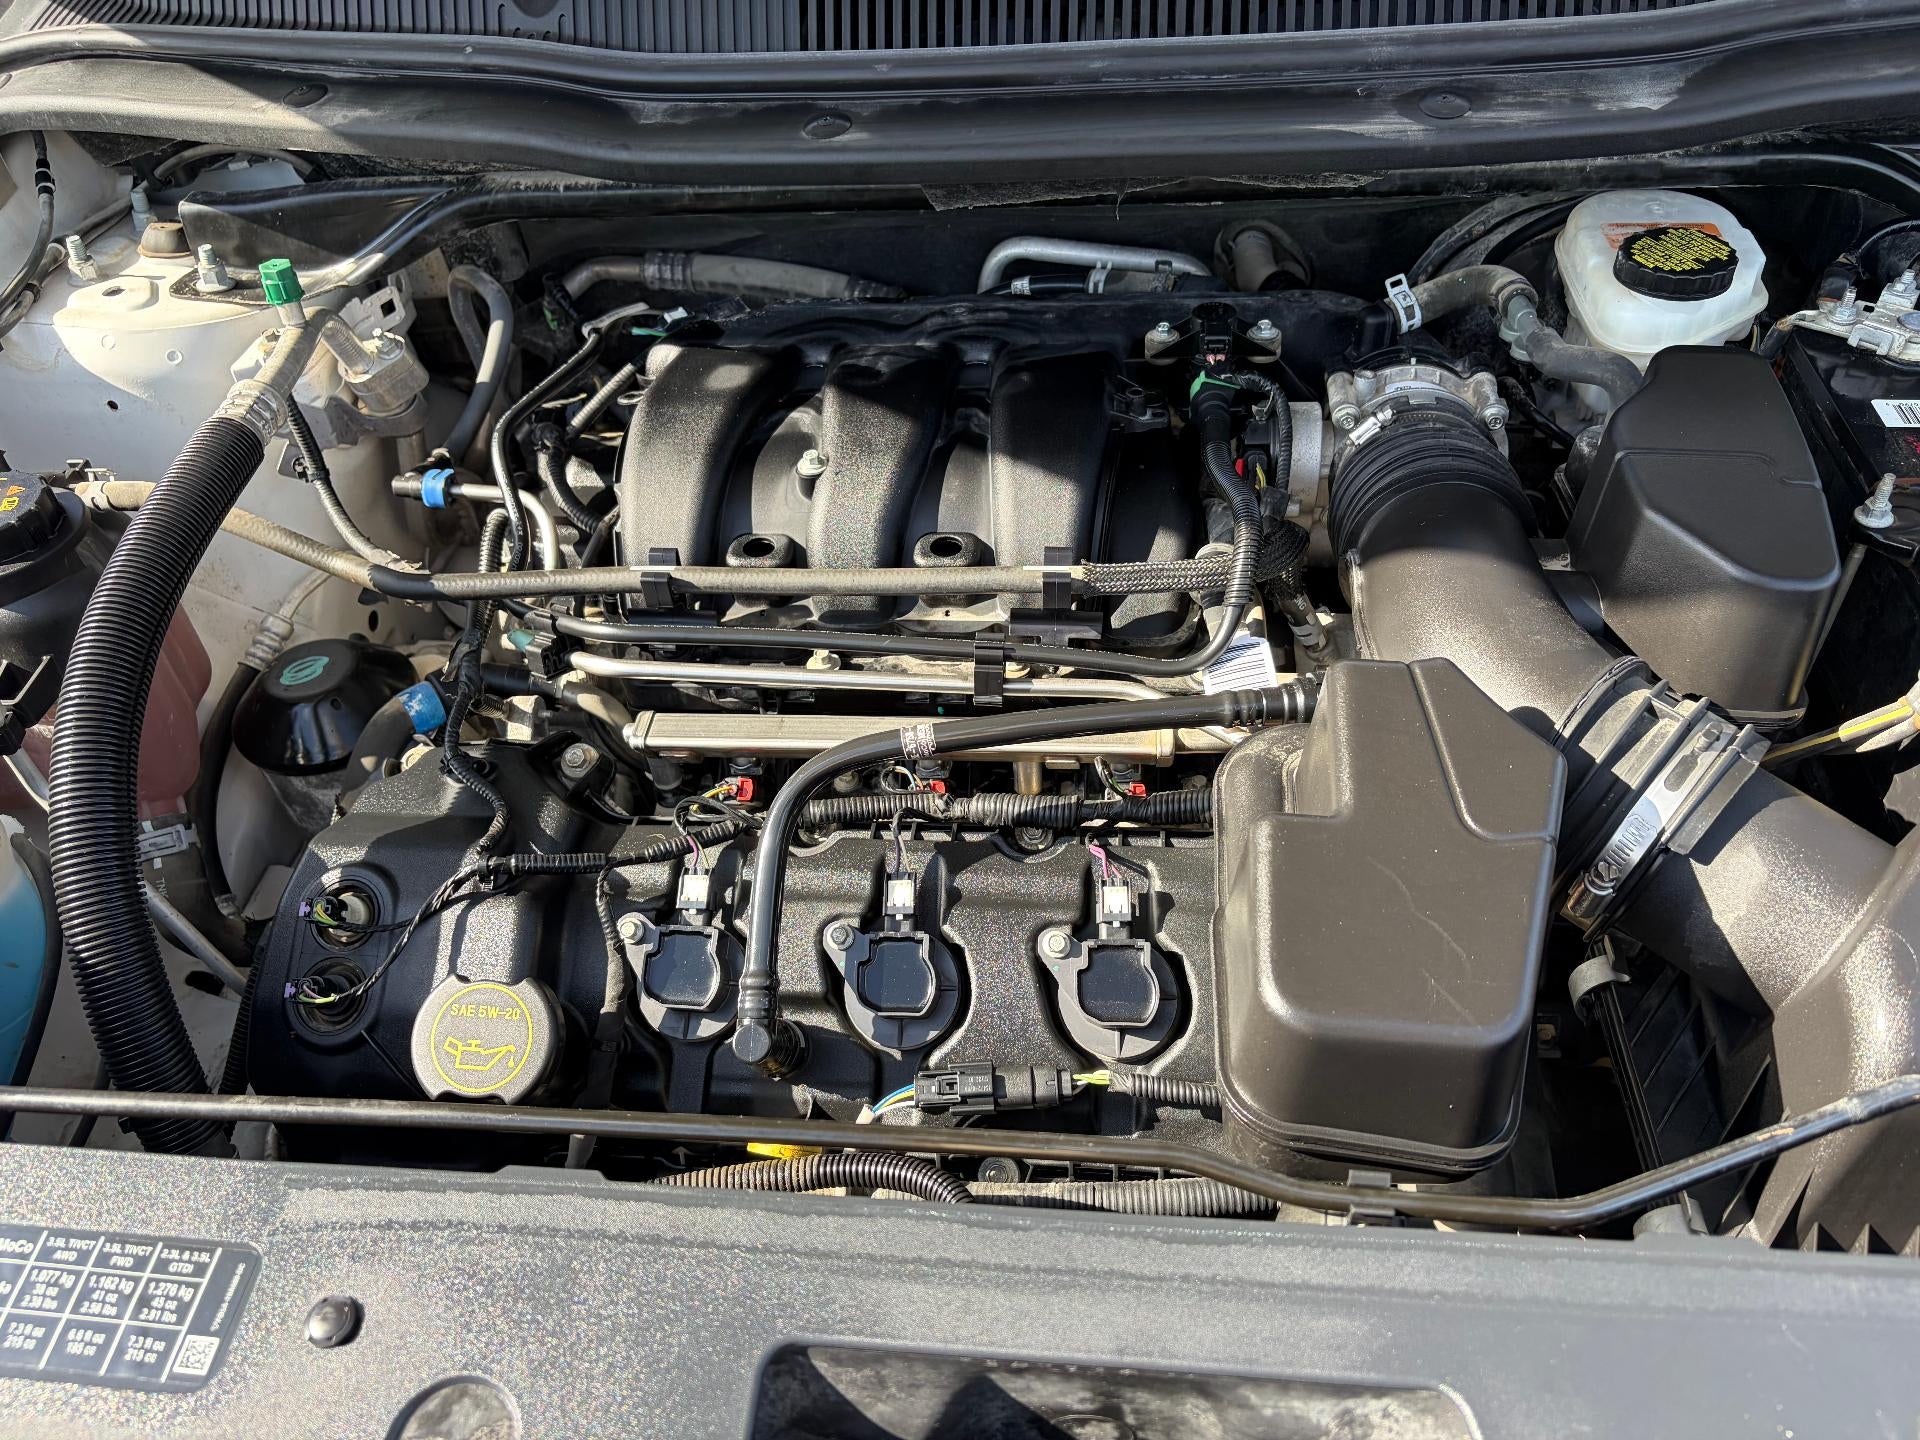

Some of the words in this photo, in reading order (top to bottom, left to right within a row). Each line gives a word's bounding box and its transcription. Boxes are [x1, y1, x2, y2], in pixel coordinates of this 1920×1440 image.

[451, 1003, 475, 1017] SAE
[478, 1005, 521, 1019] 5W-20
[52, 1250, 78, 1261] AWD
[110, 1256, 134, 1268] FWD
[181, 1251, 190, 1261] &
[59, 1271, 76, 1289] kg
[118, 1278, 135, 1295] kg
[91, 1290, 105, 1301] 41
[105, 1293, 118, 1304] oz
[178, 1284, 195, 1303] kg
[165, 1300, 178, 1310] oz
[161, 1310, 177, 1323] lbs
